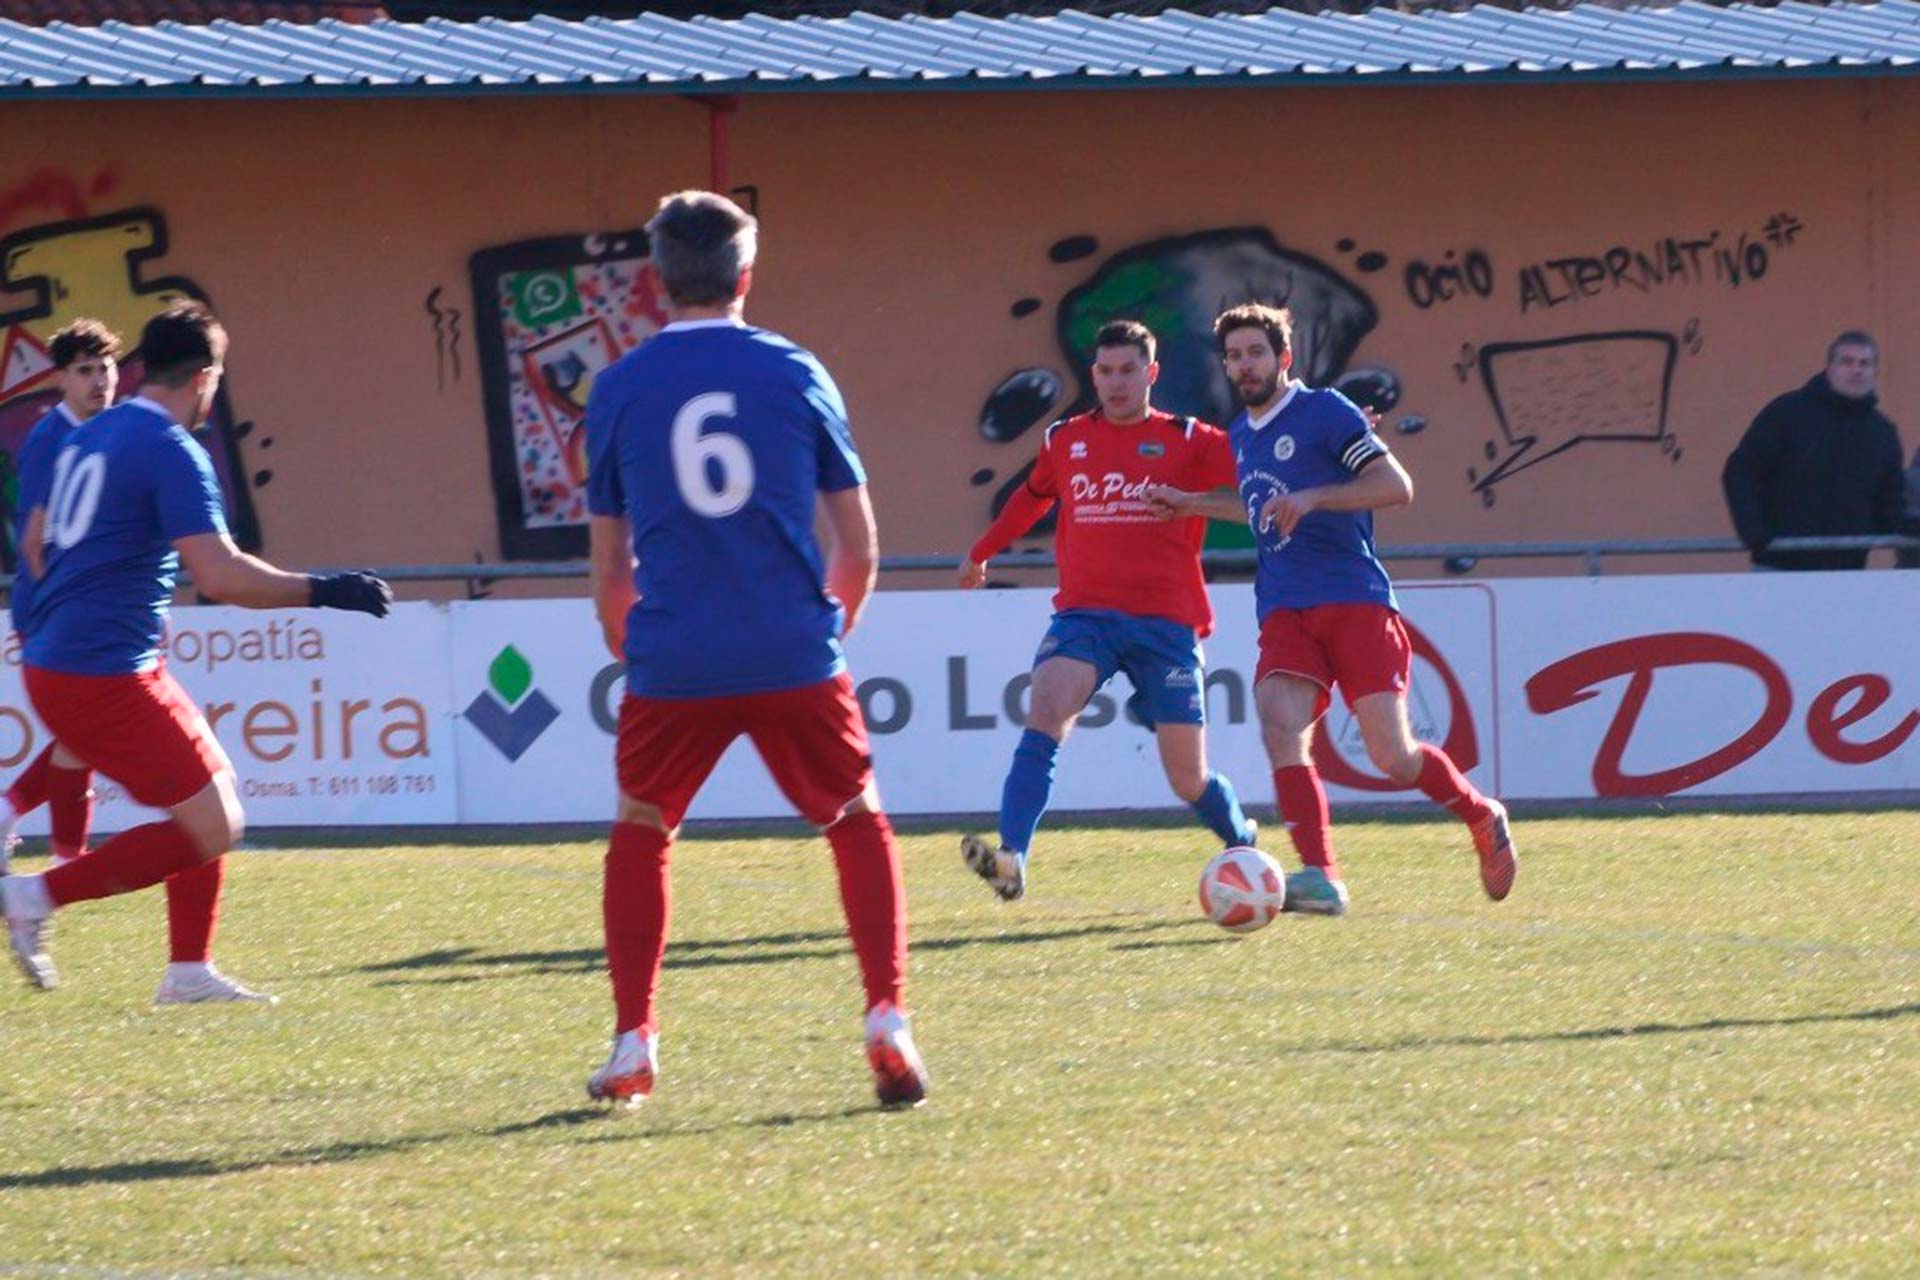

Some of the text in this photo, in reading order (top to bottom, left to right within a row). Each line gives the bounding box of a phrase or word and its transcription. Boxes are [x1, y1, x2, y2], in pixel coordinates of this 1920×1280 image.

[41, 445, 107, 550] 10
[669, 391, 756, 519] 6
[1069, 471, 1168, 501] De Ped
[1523, 631, 1920, 798] De
